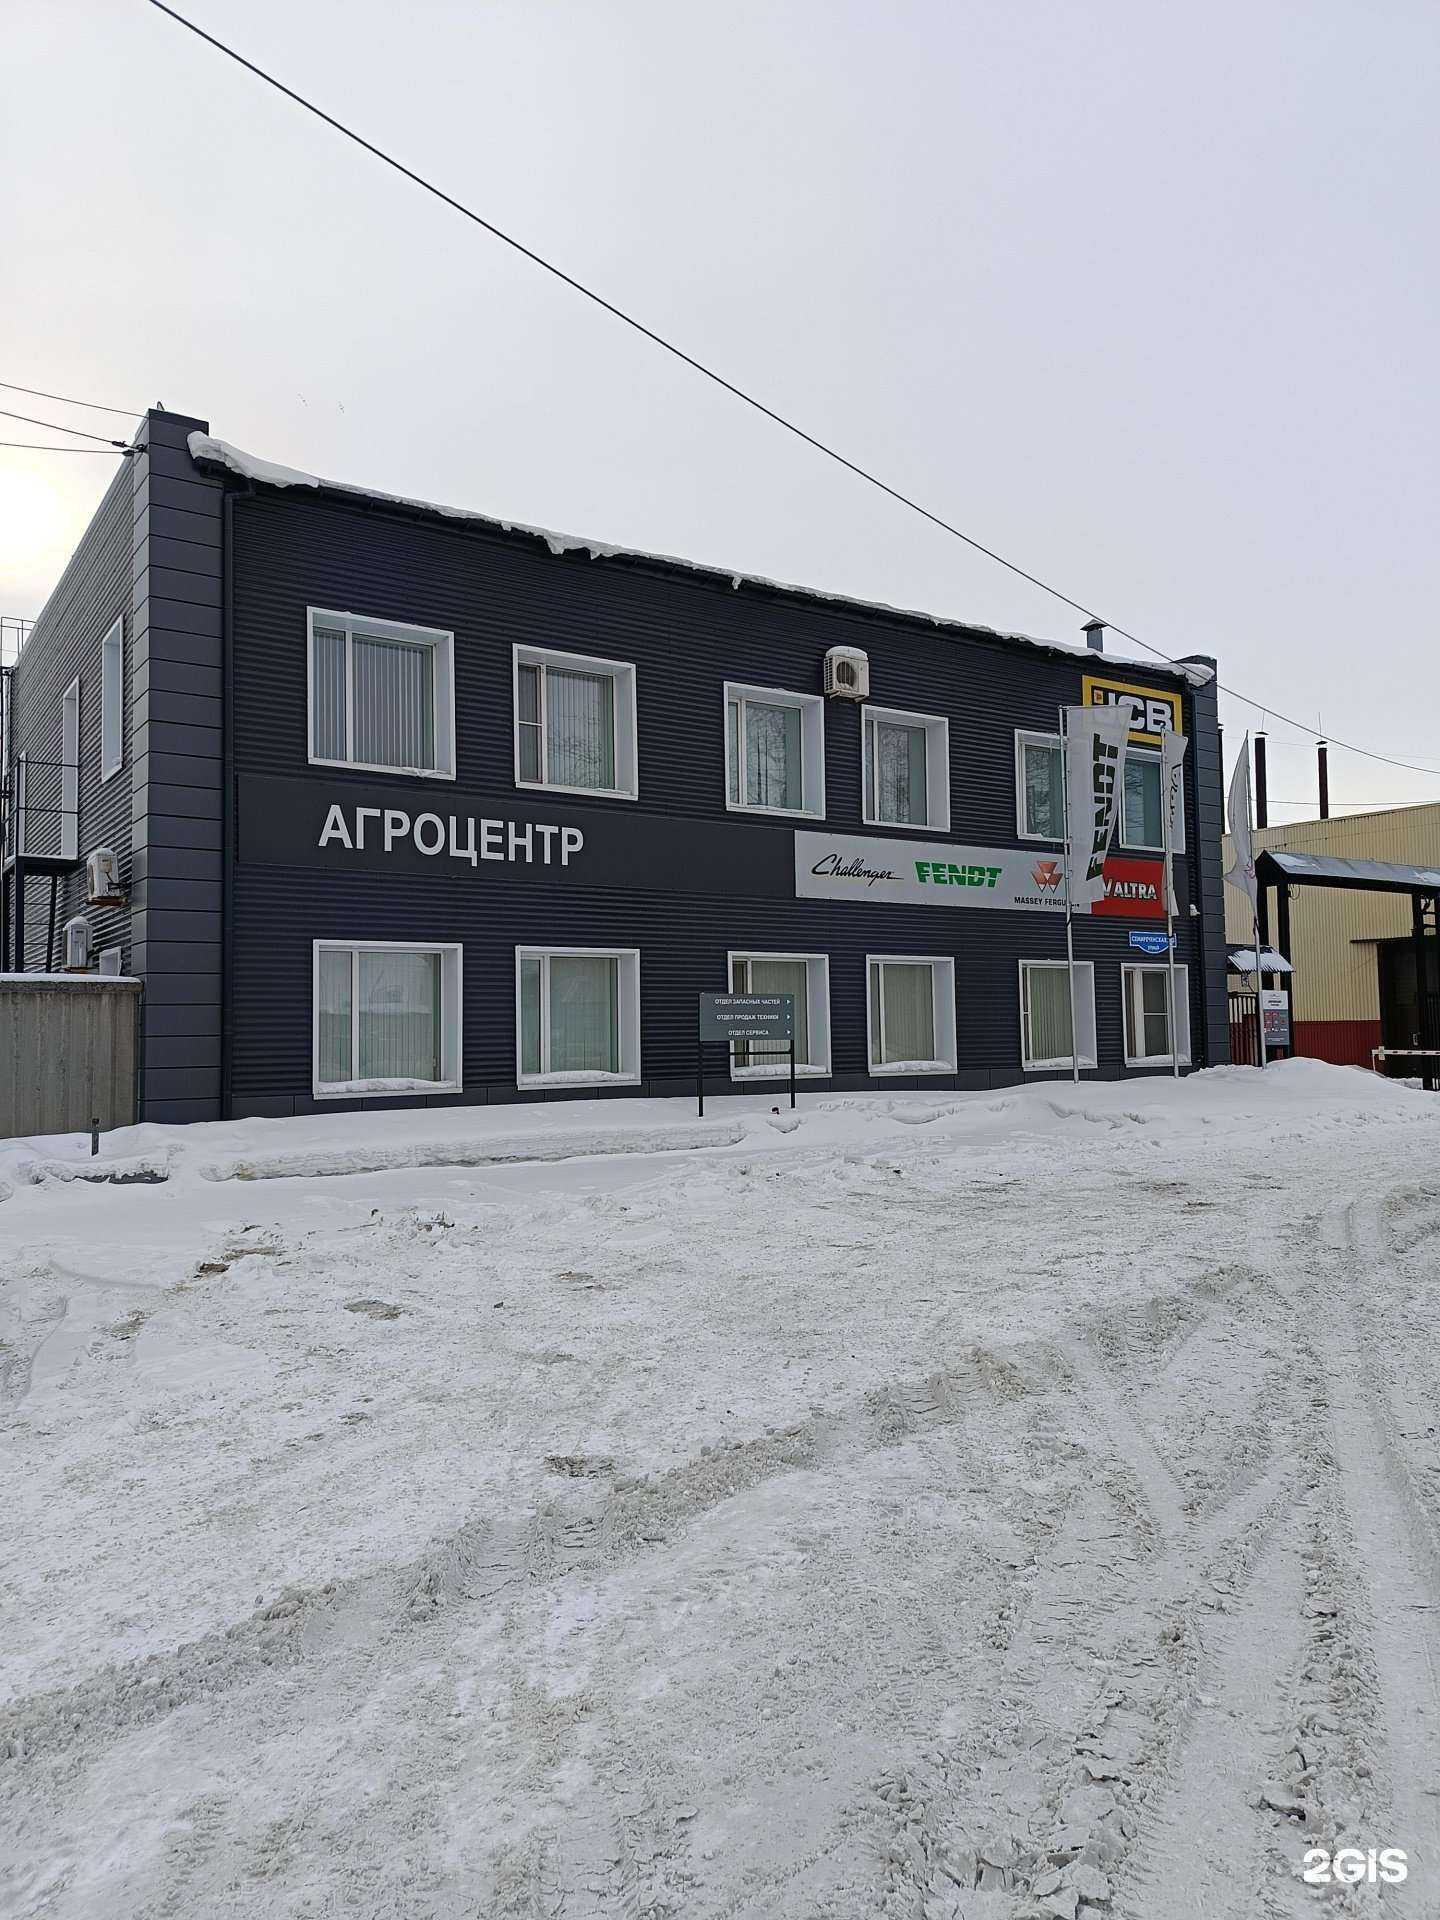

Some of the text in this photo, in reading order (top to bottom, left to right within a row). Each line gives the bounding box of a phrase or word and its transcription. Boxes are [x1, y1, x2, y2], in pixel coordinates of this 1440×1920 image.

[318, 804, 584, 867] АГРОЦЕНТР
[811, 853, 903, 887] Challenger
[914, 861, 1002, 888] FENDT
[1014, 896, 1080, 908] MASSEY FERGU
